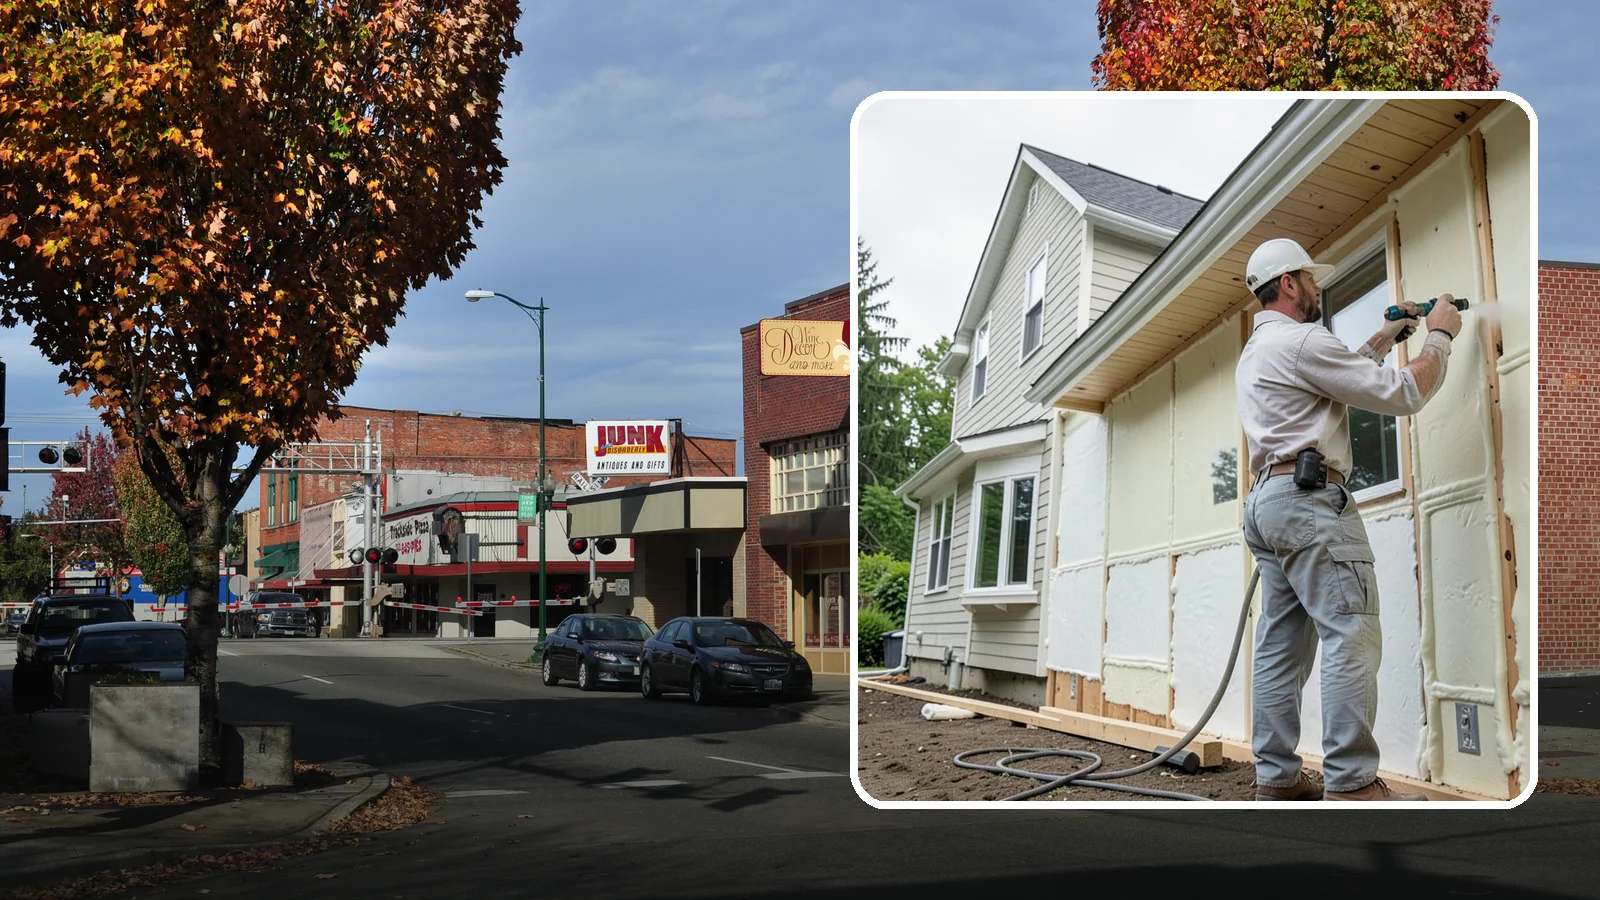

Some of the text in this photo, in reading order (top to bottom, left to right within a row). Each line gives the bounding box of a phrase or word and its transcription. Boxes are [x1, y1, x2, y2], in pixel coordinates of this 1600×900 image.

[765, 328, 831, 365] Decor
[595, 425, 664, 457] JUNK
[607, 446, 646, 454] DISORDERLY
[597, 461, 665, 470] ANTIQUES AND GIFTS
[414, 519, 429, 535] Pizza
